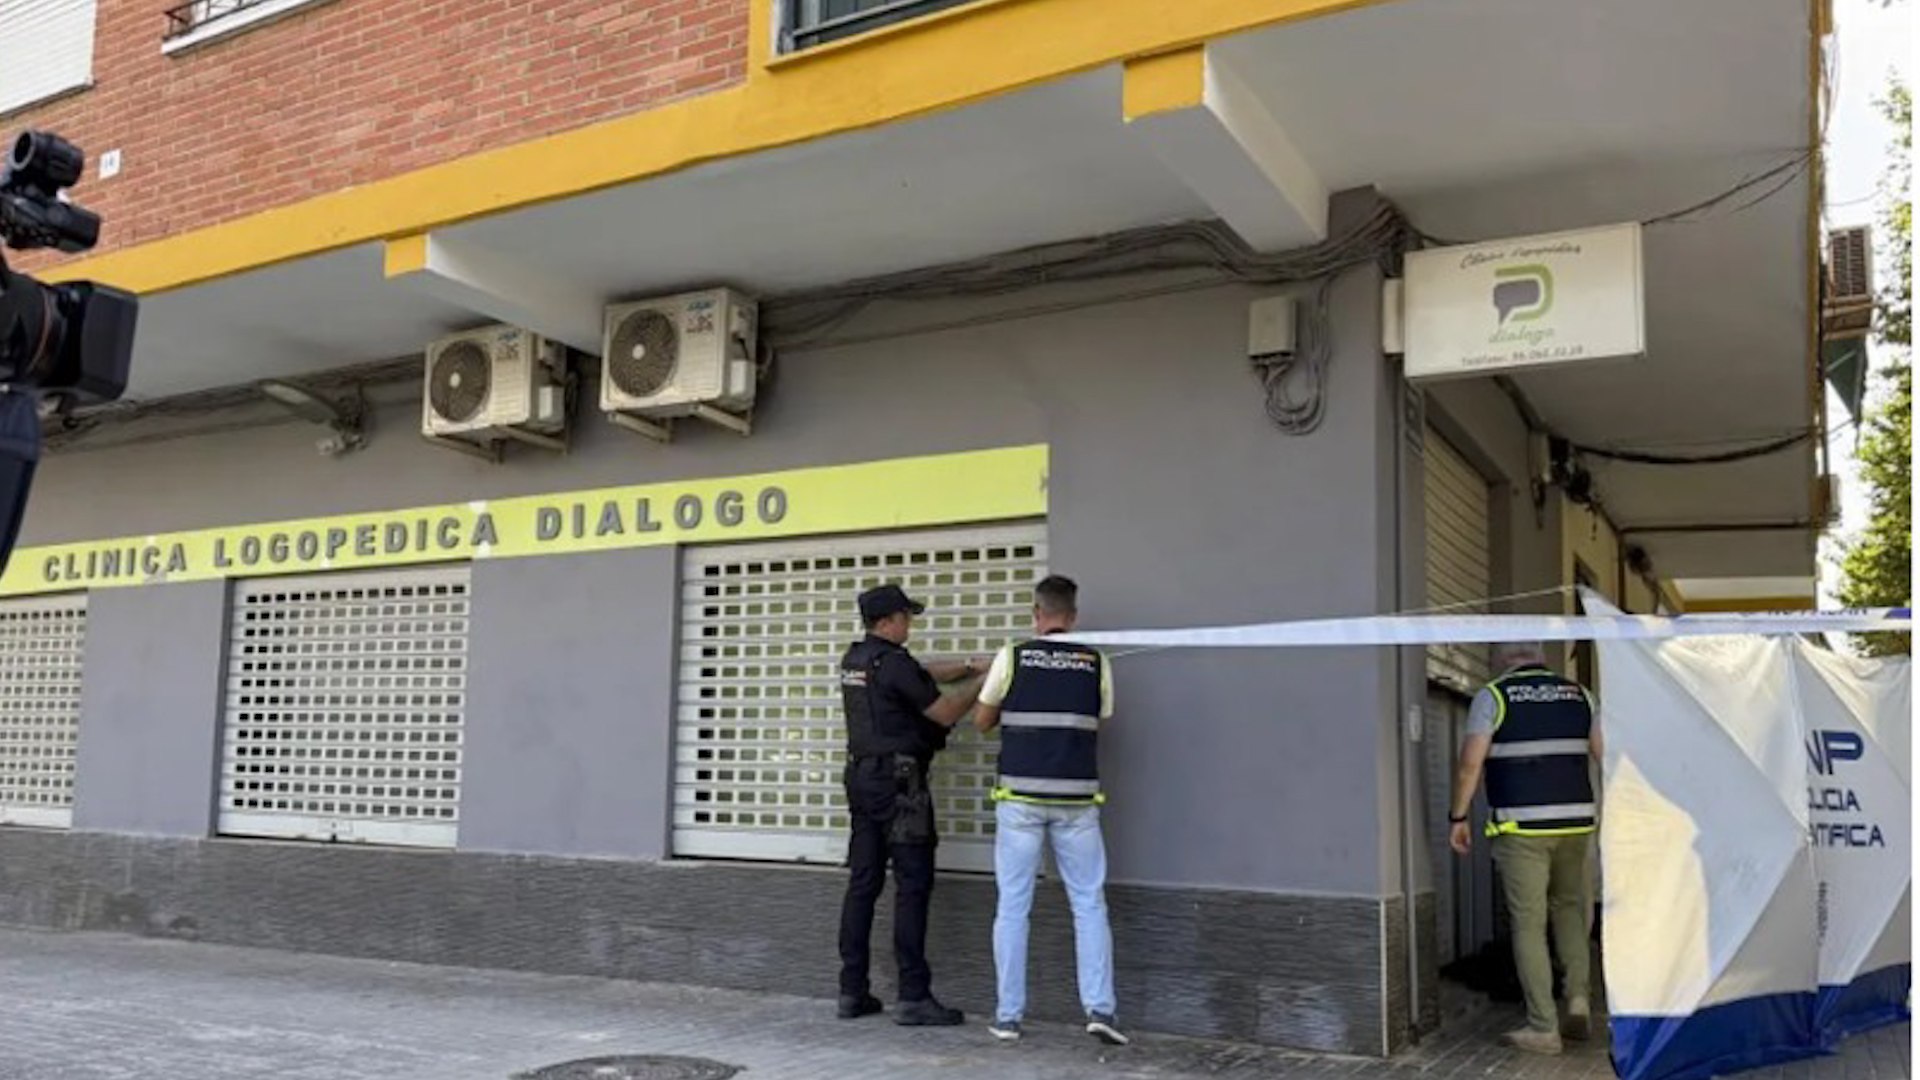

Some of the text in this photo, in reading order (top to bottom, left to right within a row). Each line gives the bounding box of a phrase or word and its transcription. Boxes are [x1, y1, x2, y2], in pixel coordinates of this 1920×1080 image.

[43, 486, 788, 583] CLINICA LOGOPEDICA DIALOGO
[1020, 658, 1096, 672] NACIONAL
[1804, 729, 1865, 776] NP
